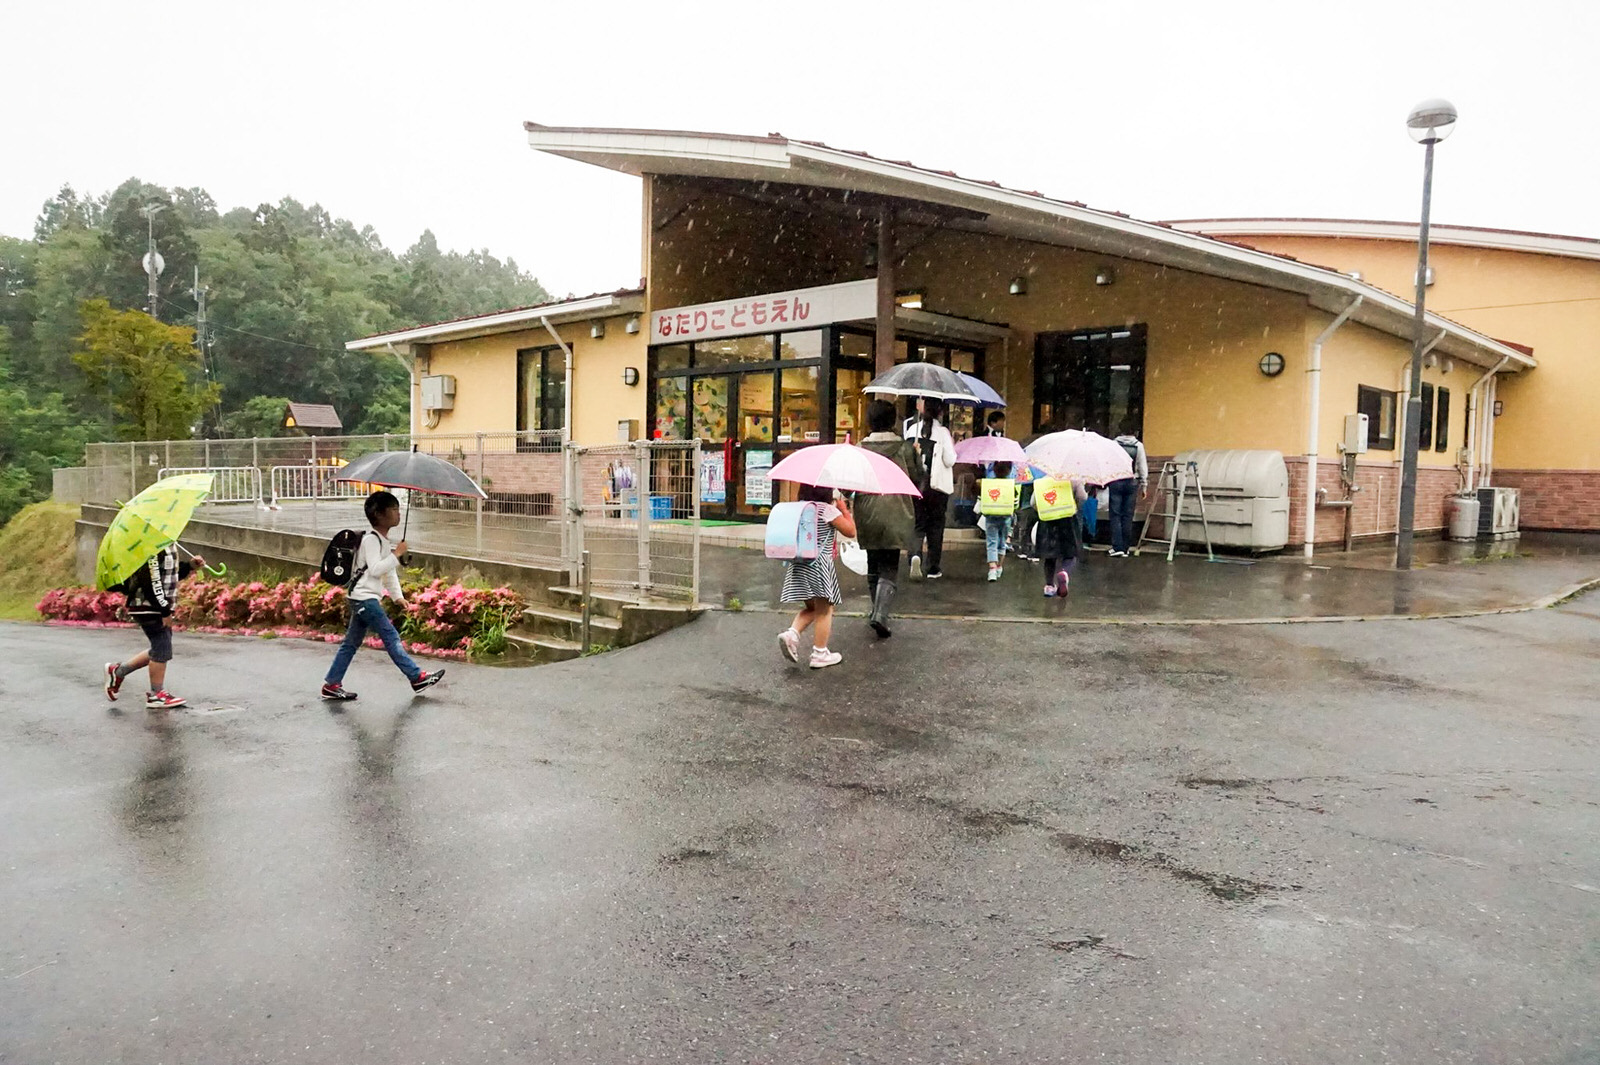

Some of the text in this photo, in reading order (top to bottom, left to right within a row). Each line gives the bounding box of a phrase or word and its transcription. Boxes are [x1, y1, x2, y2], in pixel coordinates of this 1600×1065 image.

[659, 297, 810, 336] なたりこどもえん
